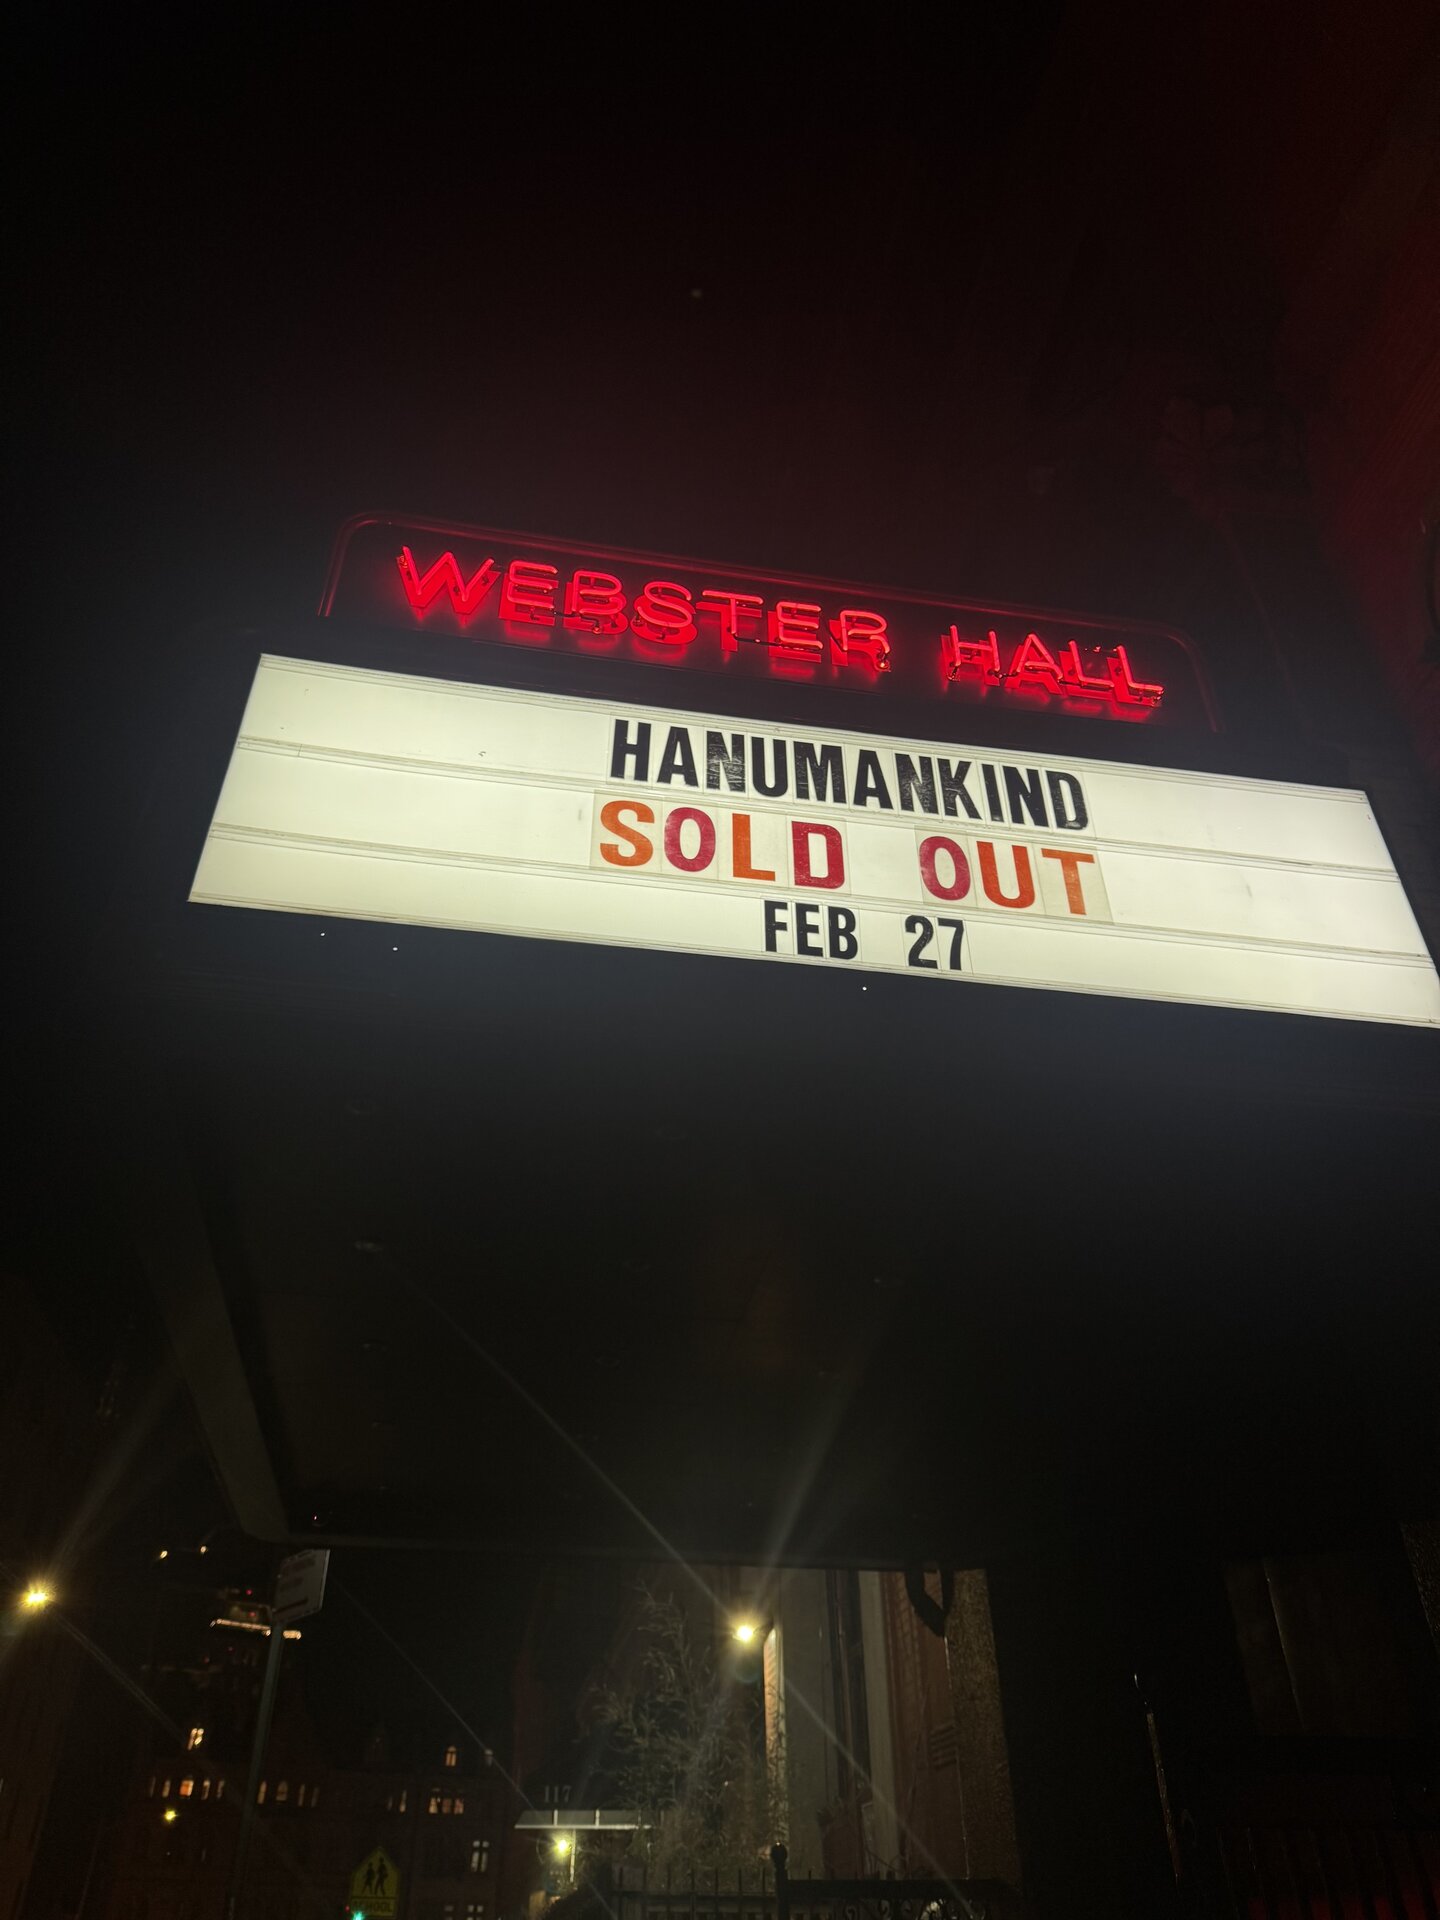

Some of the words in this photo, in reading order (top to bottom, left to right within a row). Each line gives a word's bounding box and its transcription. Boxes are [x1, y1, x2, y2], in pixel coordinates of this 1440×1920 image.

[397, 545, 892, 672] WEBSTER
[941, 624, 1165, 707] HALL
[610, 718, 1089, 830] HANUMANKIND
[599, 800, 846, 890] SOLD
[918, 836, 1096, 916] OUT
[764, 899, 859, 960] FEB
[904, 914, 965, 971] 27
[544, 1784, 572, 1803] 117
